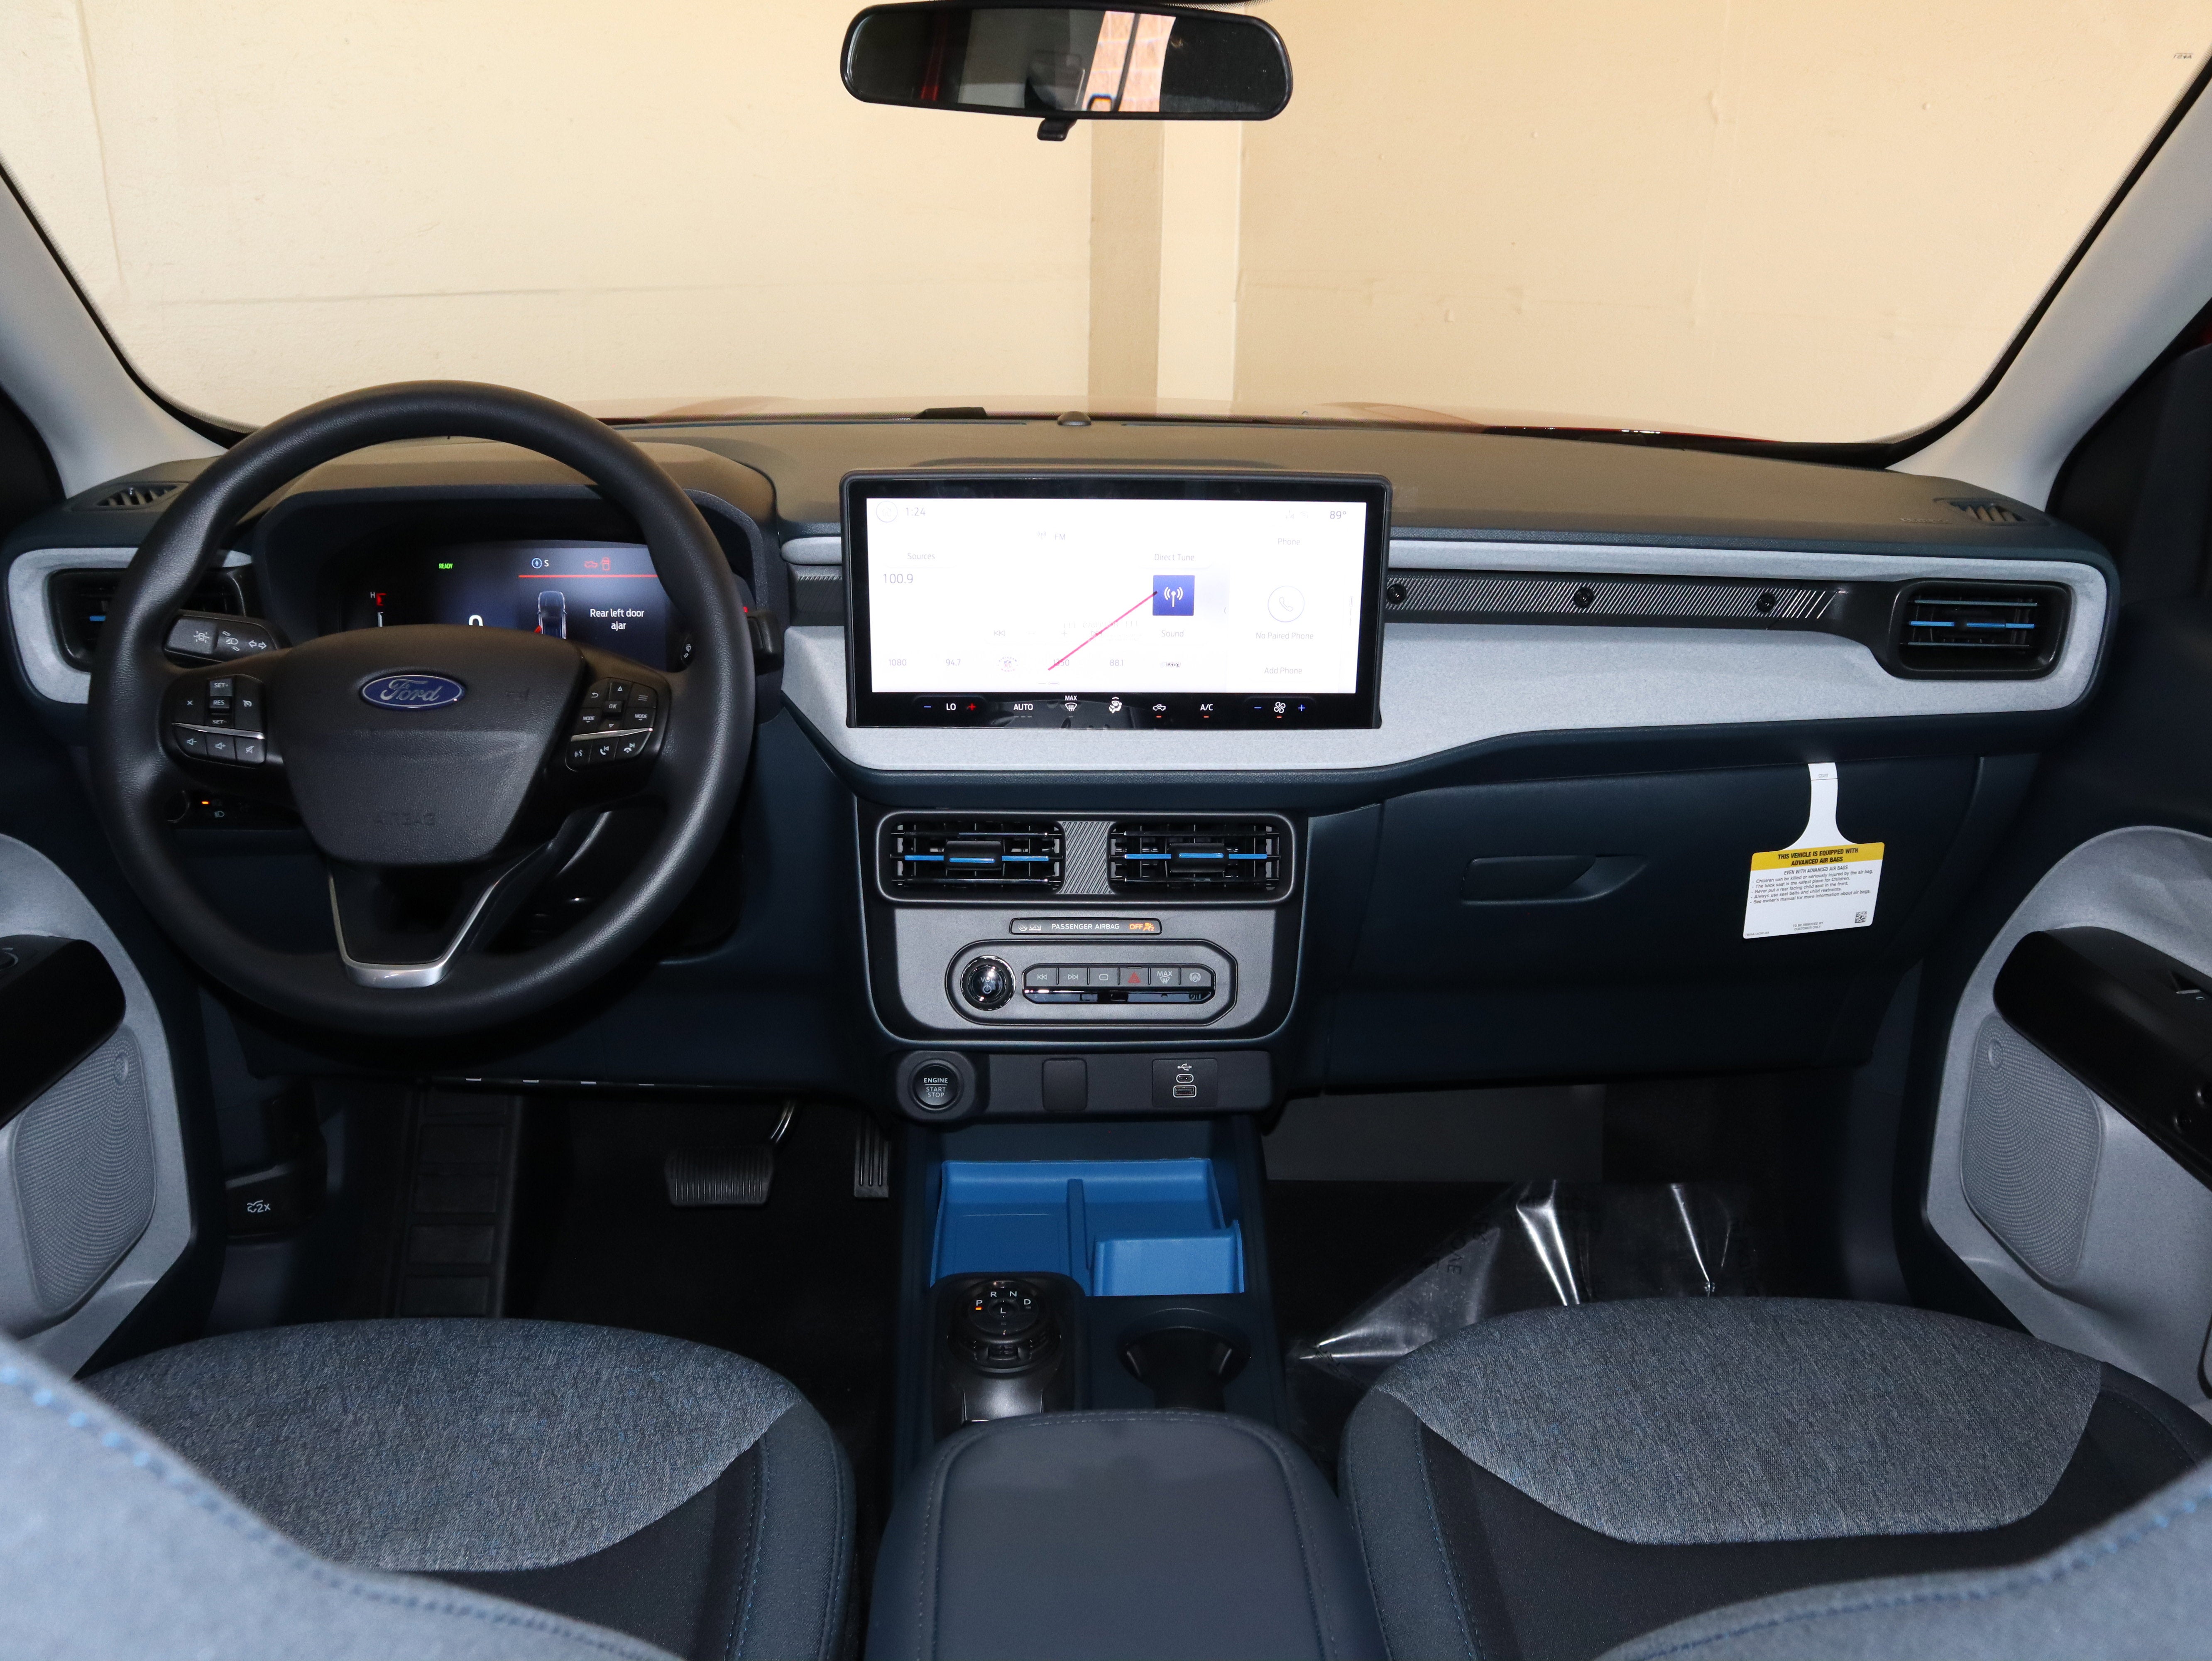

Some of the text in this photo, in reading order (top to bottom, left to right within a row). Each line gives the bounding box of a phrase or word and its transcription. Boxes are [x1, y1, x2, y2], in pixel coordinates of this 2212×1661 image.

[905, 507, 926, 517] 1:24
[883, 573, 913, 584] 100.9
[590, 608, 644, 617] Rear left door
[611, 621, 626, 631] ajar
[380, 679, 440, 702] Ford
[1013, 703, 1033, 711] AUTO
[1200, 703, 1214, 711] A/C
